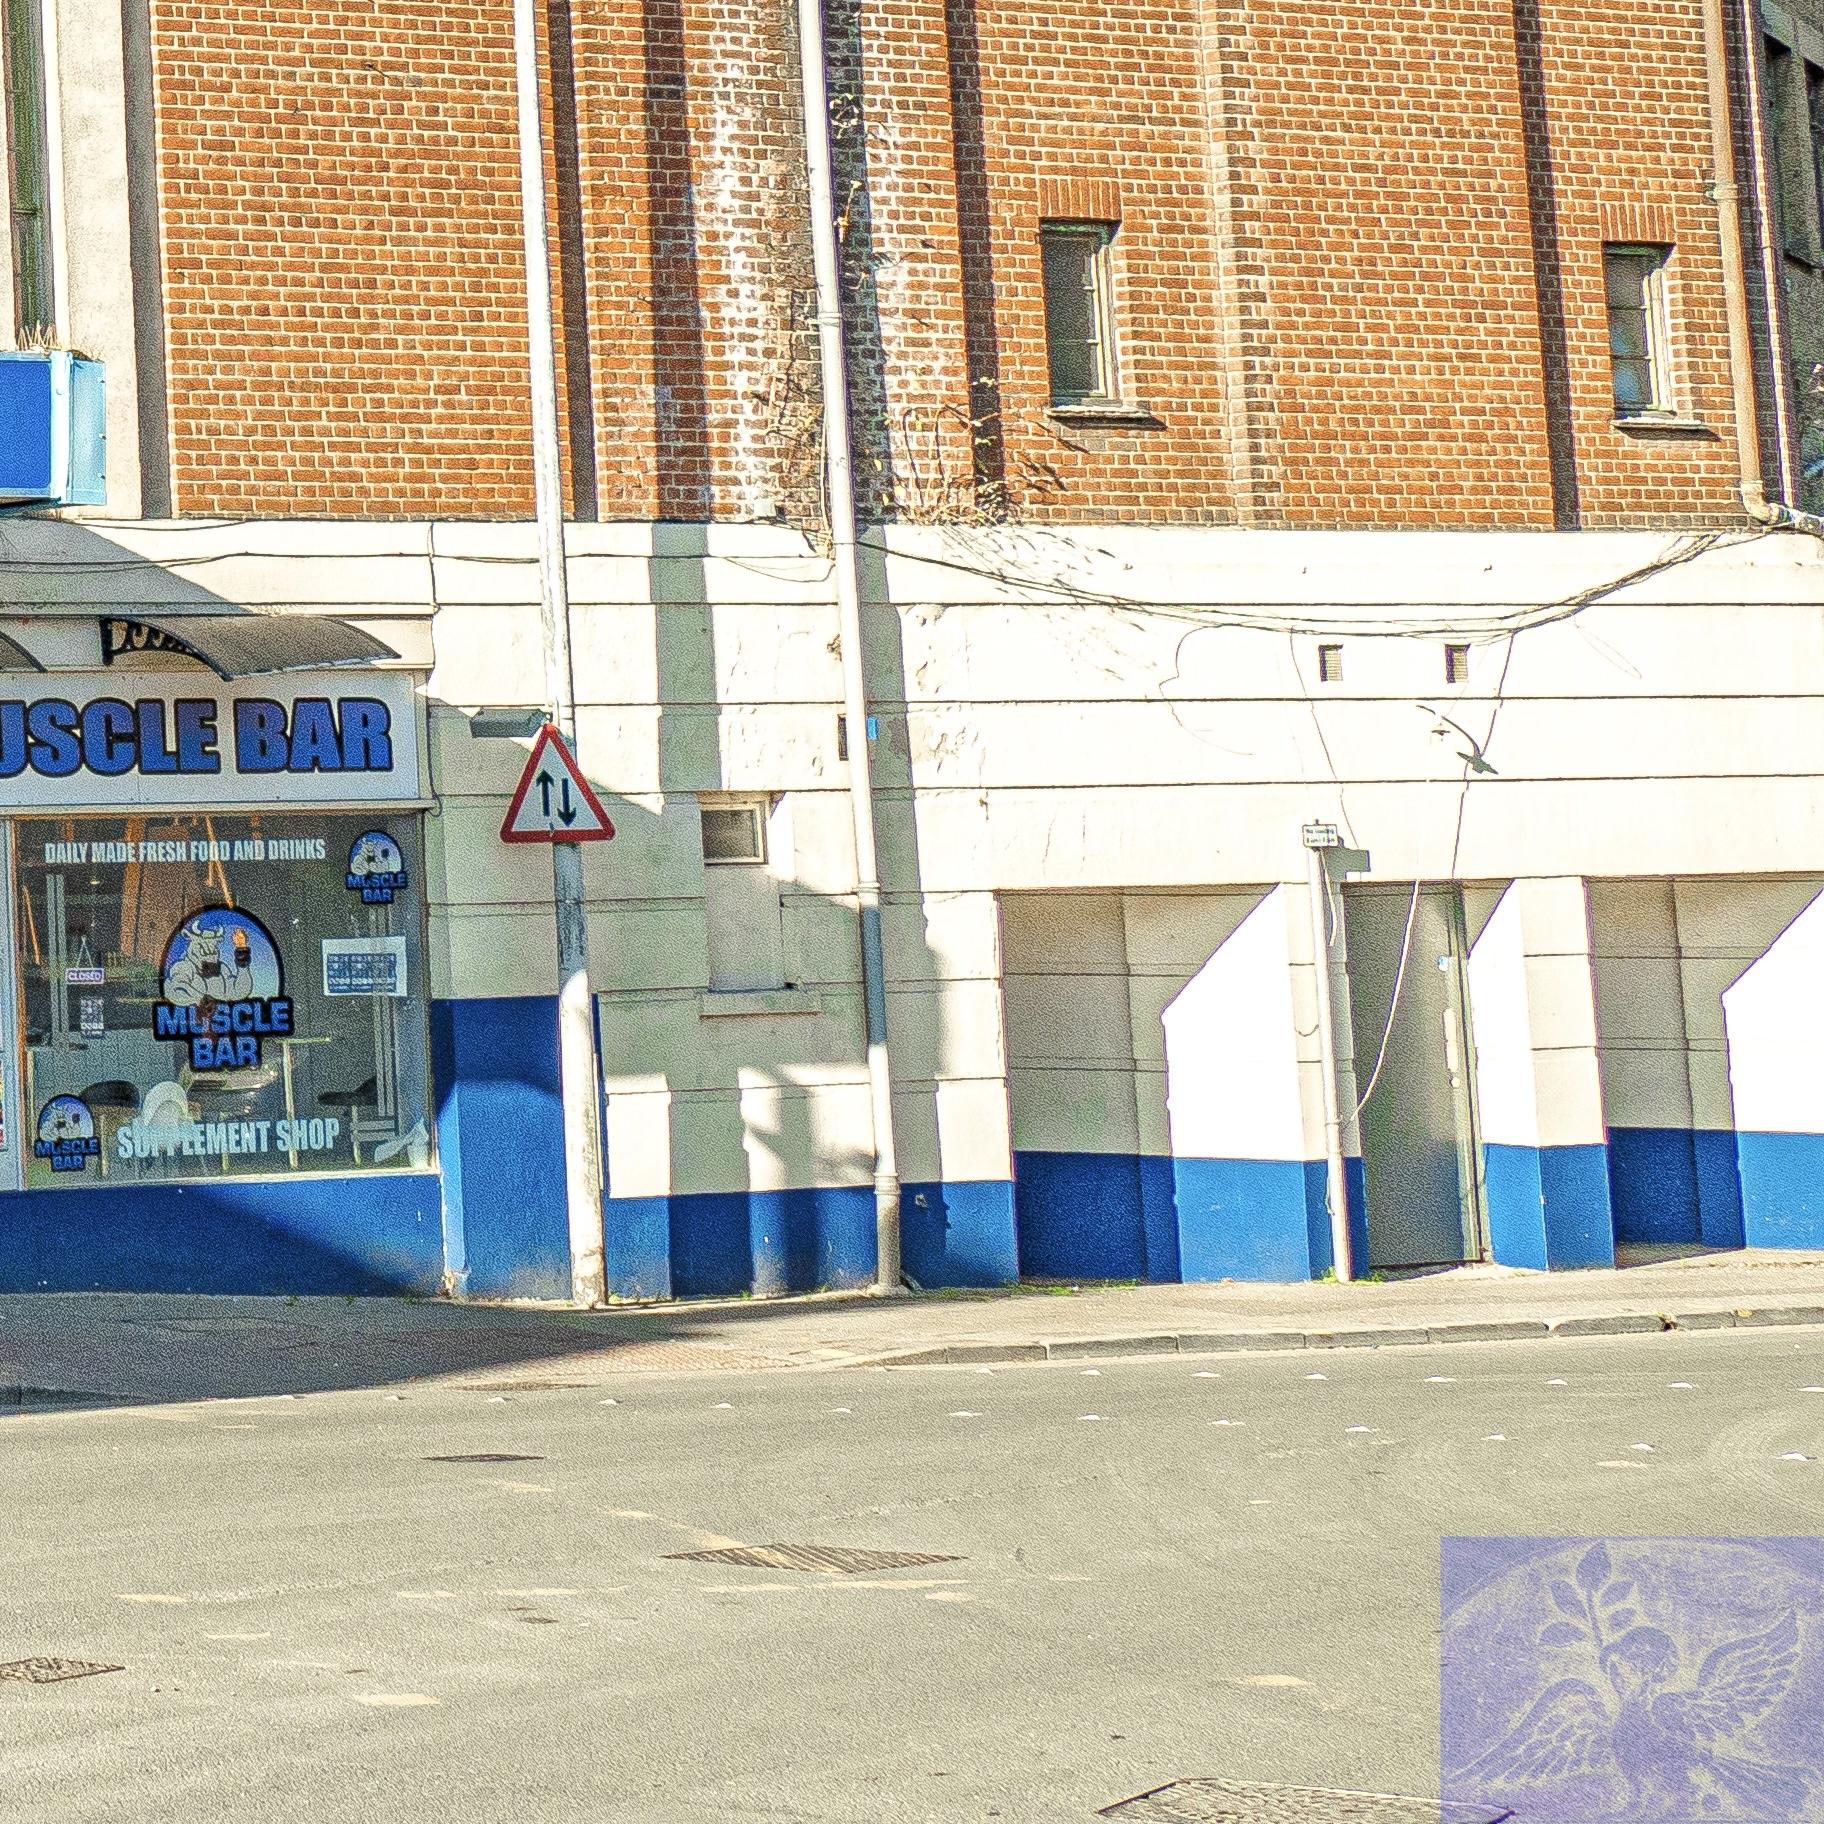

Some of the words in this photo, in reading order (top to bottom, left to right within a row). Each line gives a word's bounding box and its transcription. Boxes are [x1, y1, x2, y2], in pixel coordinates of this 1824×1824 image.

[233, 696, 395, 775] BAR
[44, 841, 88, 864] DAILY
[91, 841, 137, 863] MADE
[139, 840, 187, 862] FRESH
[190, 840, 232, 862] FOOD
[234, 839, 266, 861] AND
[269, 838, 326, 860] DRINKS
[346, 874, 408, 890] MUSCLE
[361, 888, 394, 904] BAR
[68, 971, 102, 981] CLOSED
[154, 999, 292, 1036] MUSCLE
[192, 1035, 260, 1068] BAR
[35, 1137, 100, 1157] MUSCLE
[116, 1120, 271, 1159] SUPPLEMENT
[276, 1117, 340, 1152] SHOP
[51, 1155, 84, 1171] BAR
